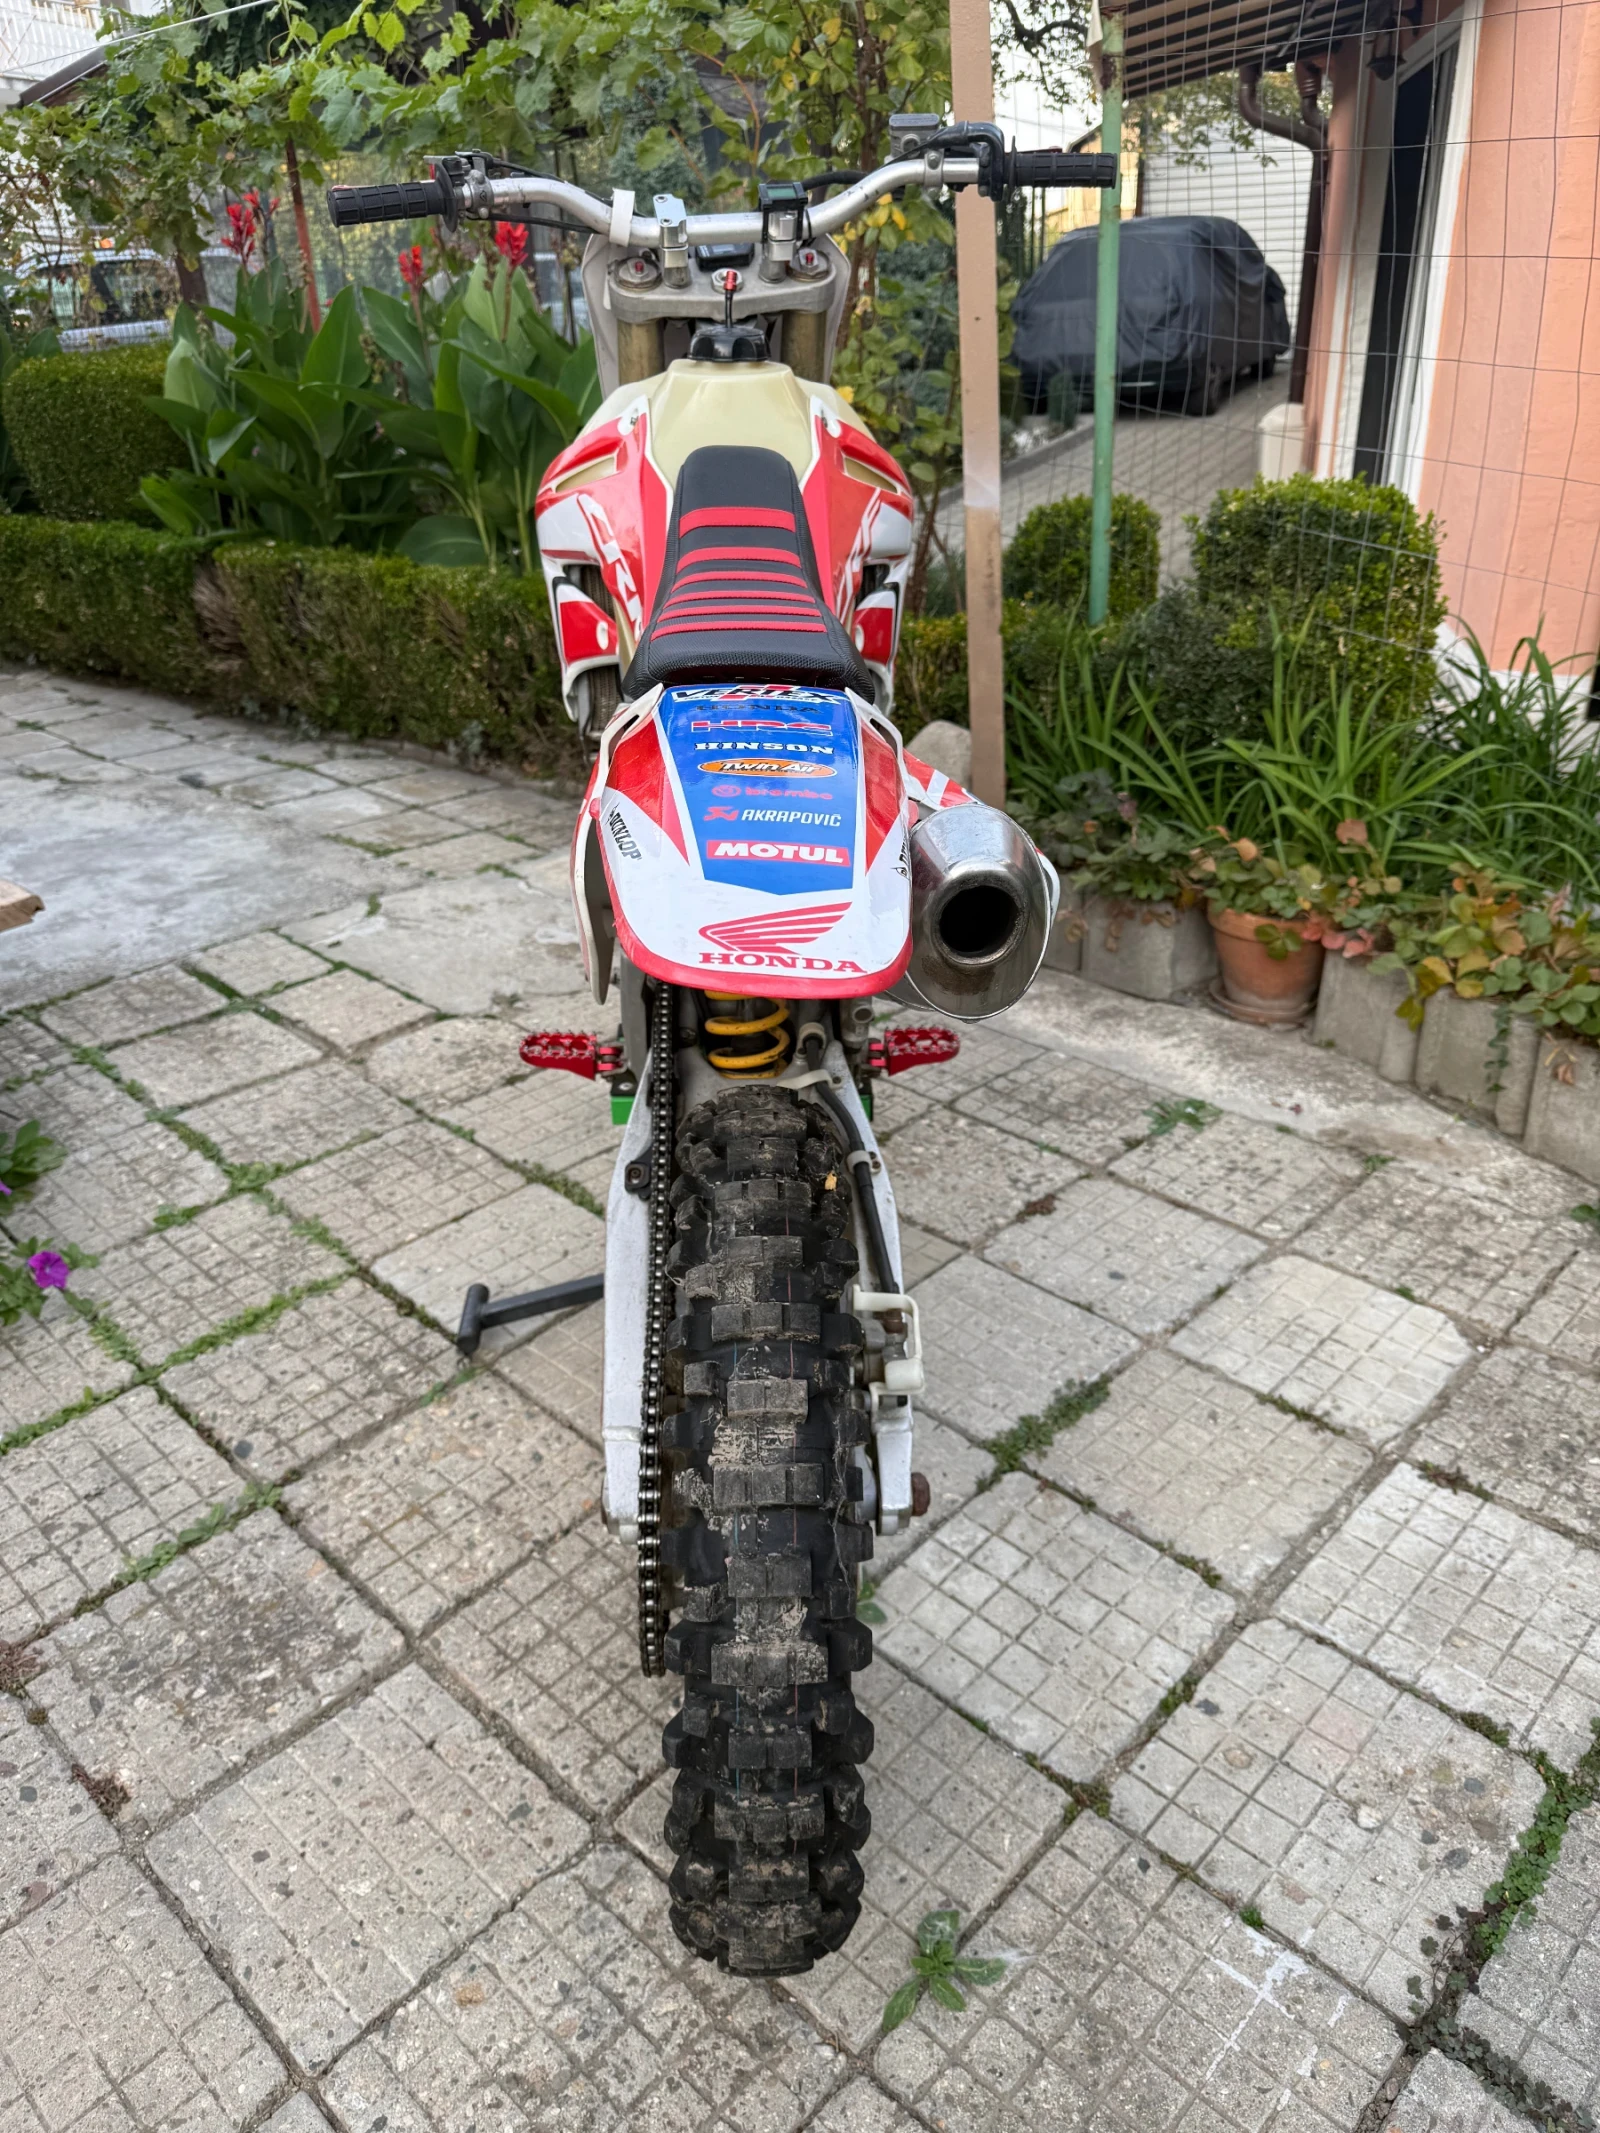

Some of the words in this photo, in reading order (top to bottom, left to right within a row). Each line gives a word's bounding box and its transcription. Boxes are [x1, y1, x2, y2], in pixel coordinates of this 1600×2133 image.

[676, 687, 835, 702] VERTEX
[696, 705, 822, 714] HONDA
[694, 741, 834, 754] HINSON
[721, 762, 778, 771] Twin
[782, 763, 821, 774] Air
[745, 788, 833, 800] brembo
[609, 812, 642, 860] DUNLOP
[714, 842, 844, 863] MOTUL
[699, 953, 867, 973] HONDA
